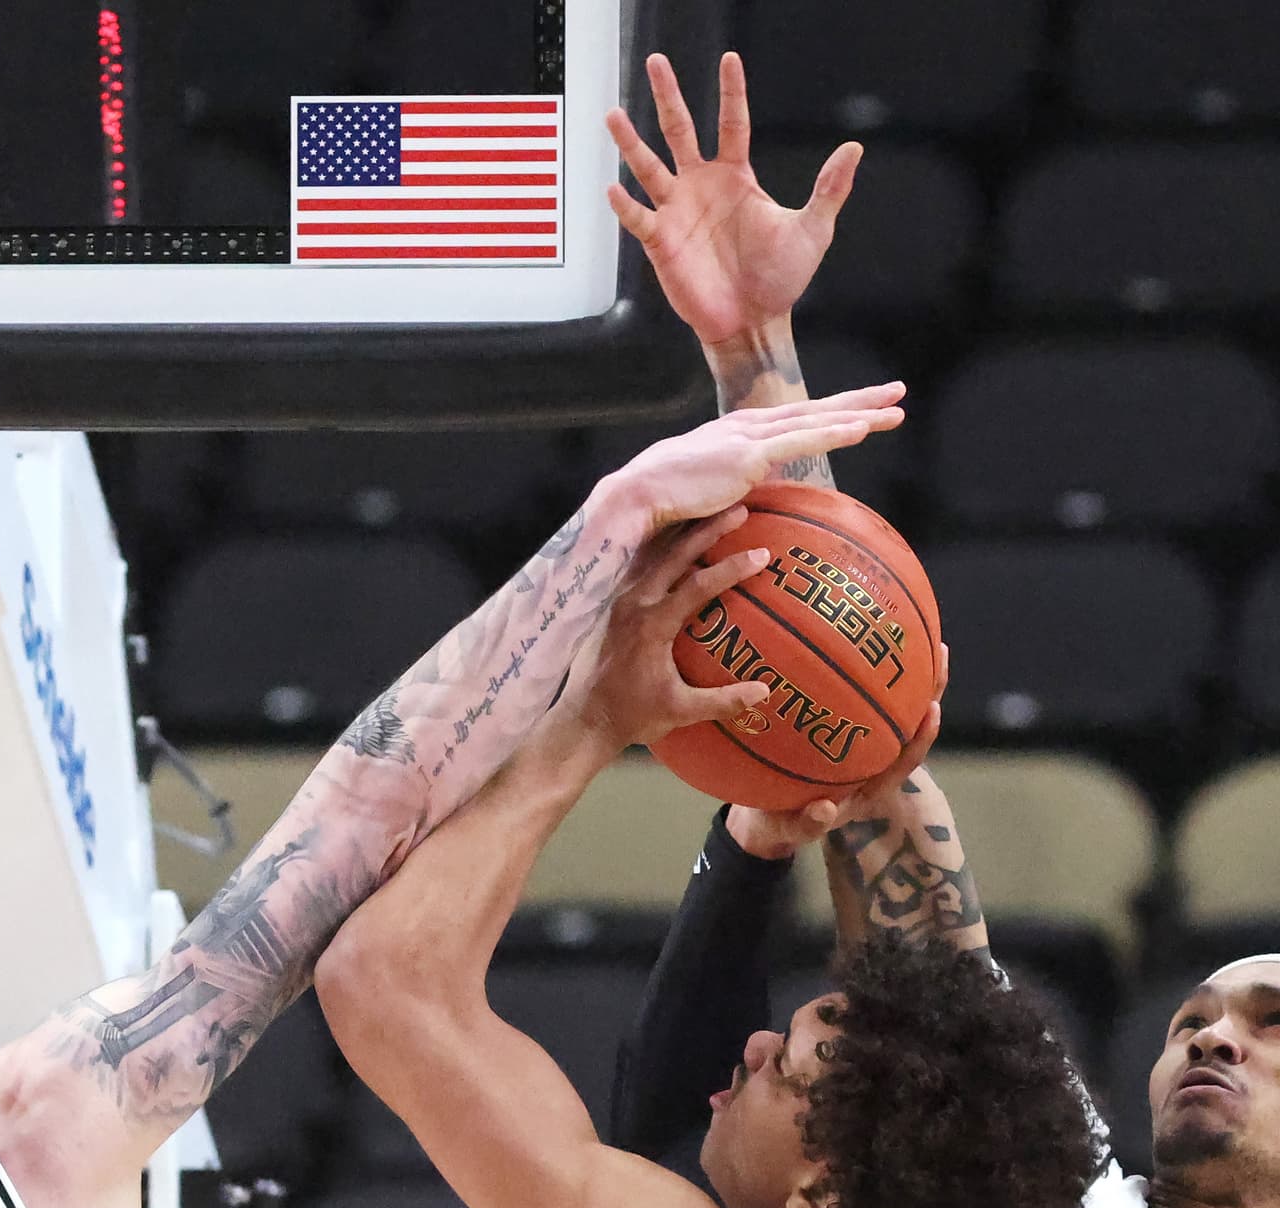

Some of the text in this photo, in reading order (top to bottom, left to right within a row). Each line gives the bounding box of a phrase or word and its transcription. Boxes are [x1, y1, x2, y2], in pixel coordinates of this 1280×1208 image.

[539, 609, 556, 632] who
[684, 596, 872, 764] SPALDING
[766, 555, 905, 690] LEGACY
